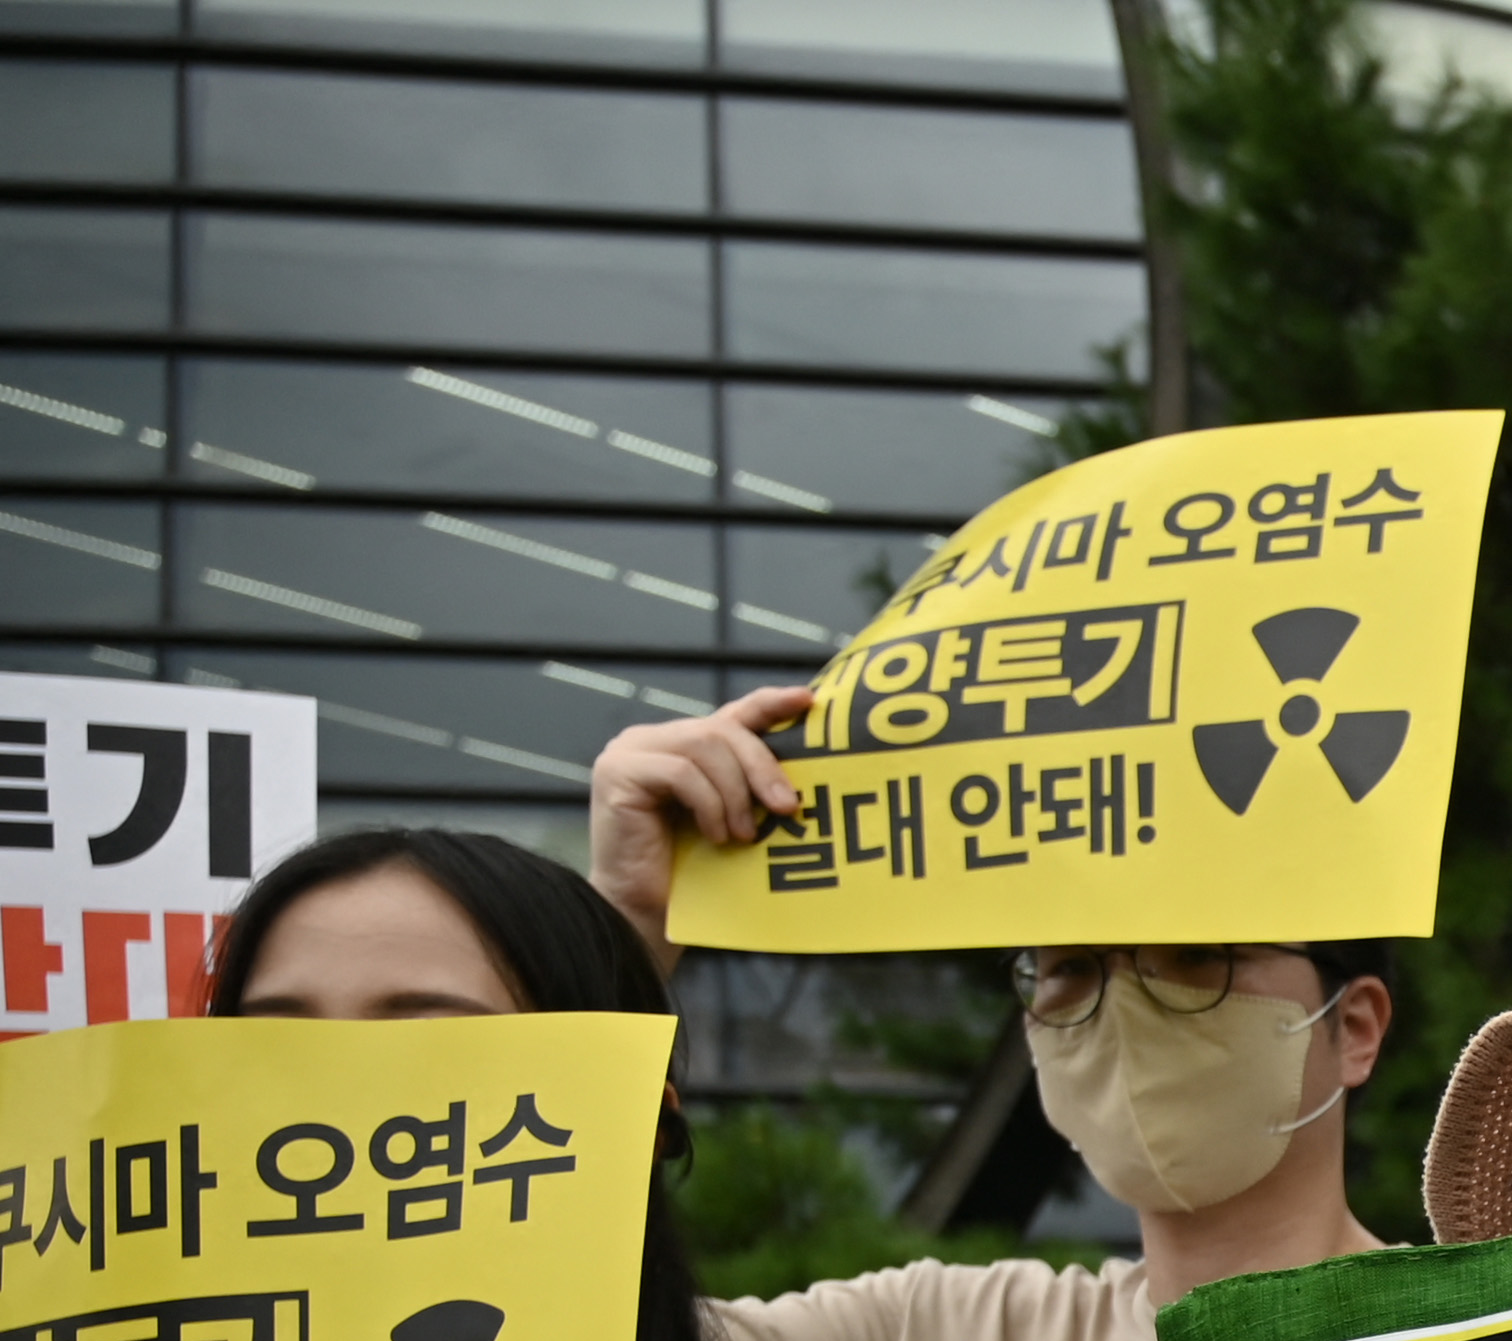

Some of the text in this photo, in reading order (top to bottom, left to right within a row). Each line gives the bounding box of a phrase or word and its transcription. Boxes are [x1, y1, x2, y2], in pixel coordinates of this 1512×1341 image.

[1149, 467, 1424, 567] 오염수
[750, 753, 1157, 893] 절대 안돼!
[246, 1093, 576, 1241] 오염수
